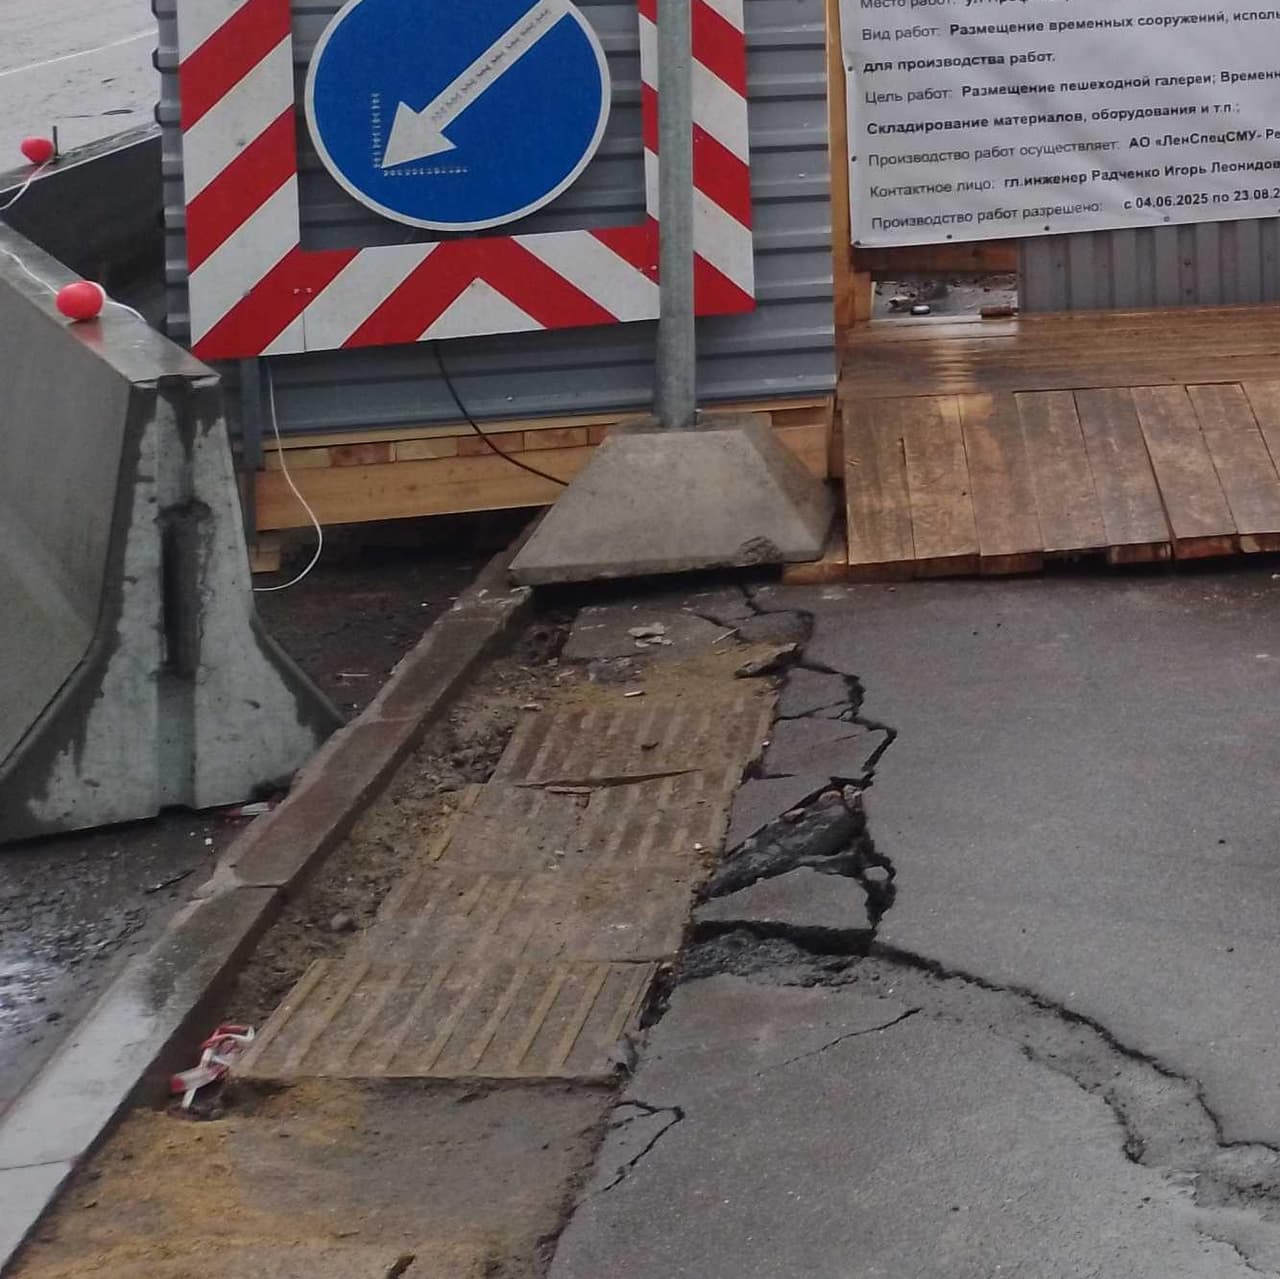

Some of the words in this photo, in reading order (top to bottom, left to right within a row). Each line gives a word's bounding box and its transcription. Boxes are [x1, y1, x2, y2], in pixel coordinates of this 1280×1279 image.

[861, 29, 892, 40] Вид
[949, 23, 1046, 35] Размещение
[1048, 18, 1134, 32] временных
[1137, 11, 1230, 27] сооружений,
[863, 62, 894, 73] для
[896, 56, 1006, 72] производства
[1009, 51, 1056, 66] работ.
[864, 92, 904, 104] Цель
[960, 84, 1057, 97] Размещение
[1059, 76, 1151, 91] пешеходной
[1154, 75, 1218, 87] галереи;
[866, 119, 990, 134] Складирование
[992, 113, 1089, 126] материалов,
[1091, 106, 1198, 121] оборудования
[867, 151, 971, 168] Производство
[973, 146, 1016, 162] работ
[1128, 137, 1151, 148] АО
[869, 184, 953, 197] Контактное
[1003, 174, 1088, 187] гл.инженер
[1090, 169, 1161, 181] Радченко
[1163, 165, 1208, 177] Игорь
[870, 213, 974, 231] Производство
[976, 208, 1019, 224] работ
[1021, 203, 1103, 220] разрешено:
[1123, 201, 1133, 209] с
[1135, 193, 1209, 208] 04.06.2025
[1212, 194, 1230, 203] по
